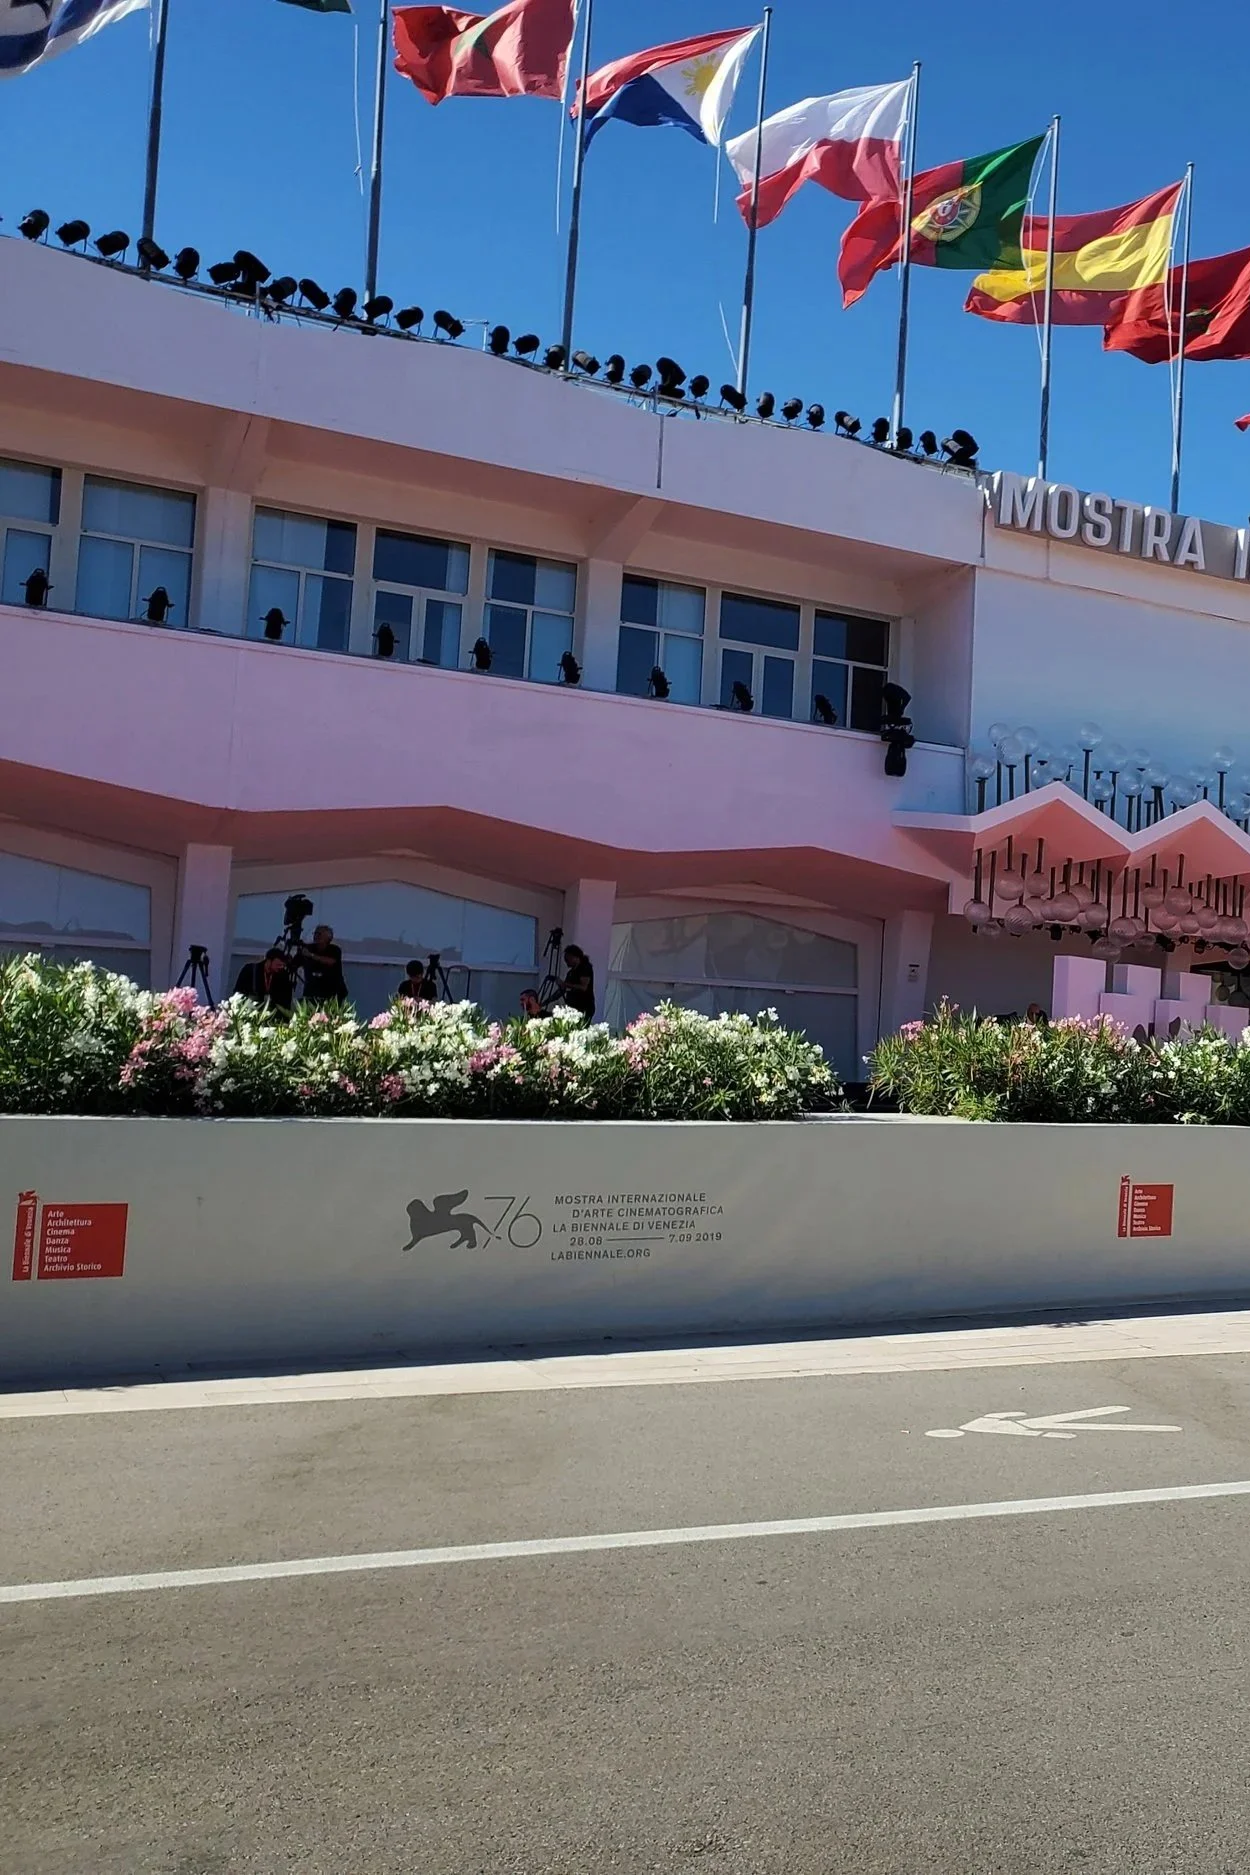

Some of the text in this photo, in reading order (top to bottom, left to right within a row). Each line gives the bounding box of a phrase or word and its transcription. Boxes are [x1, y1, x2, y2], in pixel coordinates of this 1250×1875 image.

[994, 471, 1206, 571] MOSTRA
[554, 1192, 707, 1205] MOSTRA INTERNAZIONALE
[48, 1210, 64, 1218] Arte
[572, 1205, 724, 1218] D'ARTE CINEMATOGRAFICA
[47, 1219, 92, 1227] Architettura
[482, 1196, 543, 1249] 76
[552, 1220, 696, 1233] LA BIENNALE DI VENEZIA
[46, 1228, 75, 1236] Cinema
[569, 1236, 603, 1246] 28.08
[695, 1232, 722, 1242] 2019
[45, 1246, 71, 1254] Musica
[551, 1248, 651, 1261] LABIENNALE.ORG
[45, 1255, 68, 1263] Teatro
[43, 1263, 102, 1272] Archivio Storico
